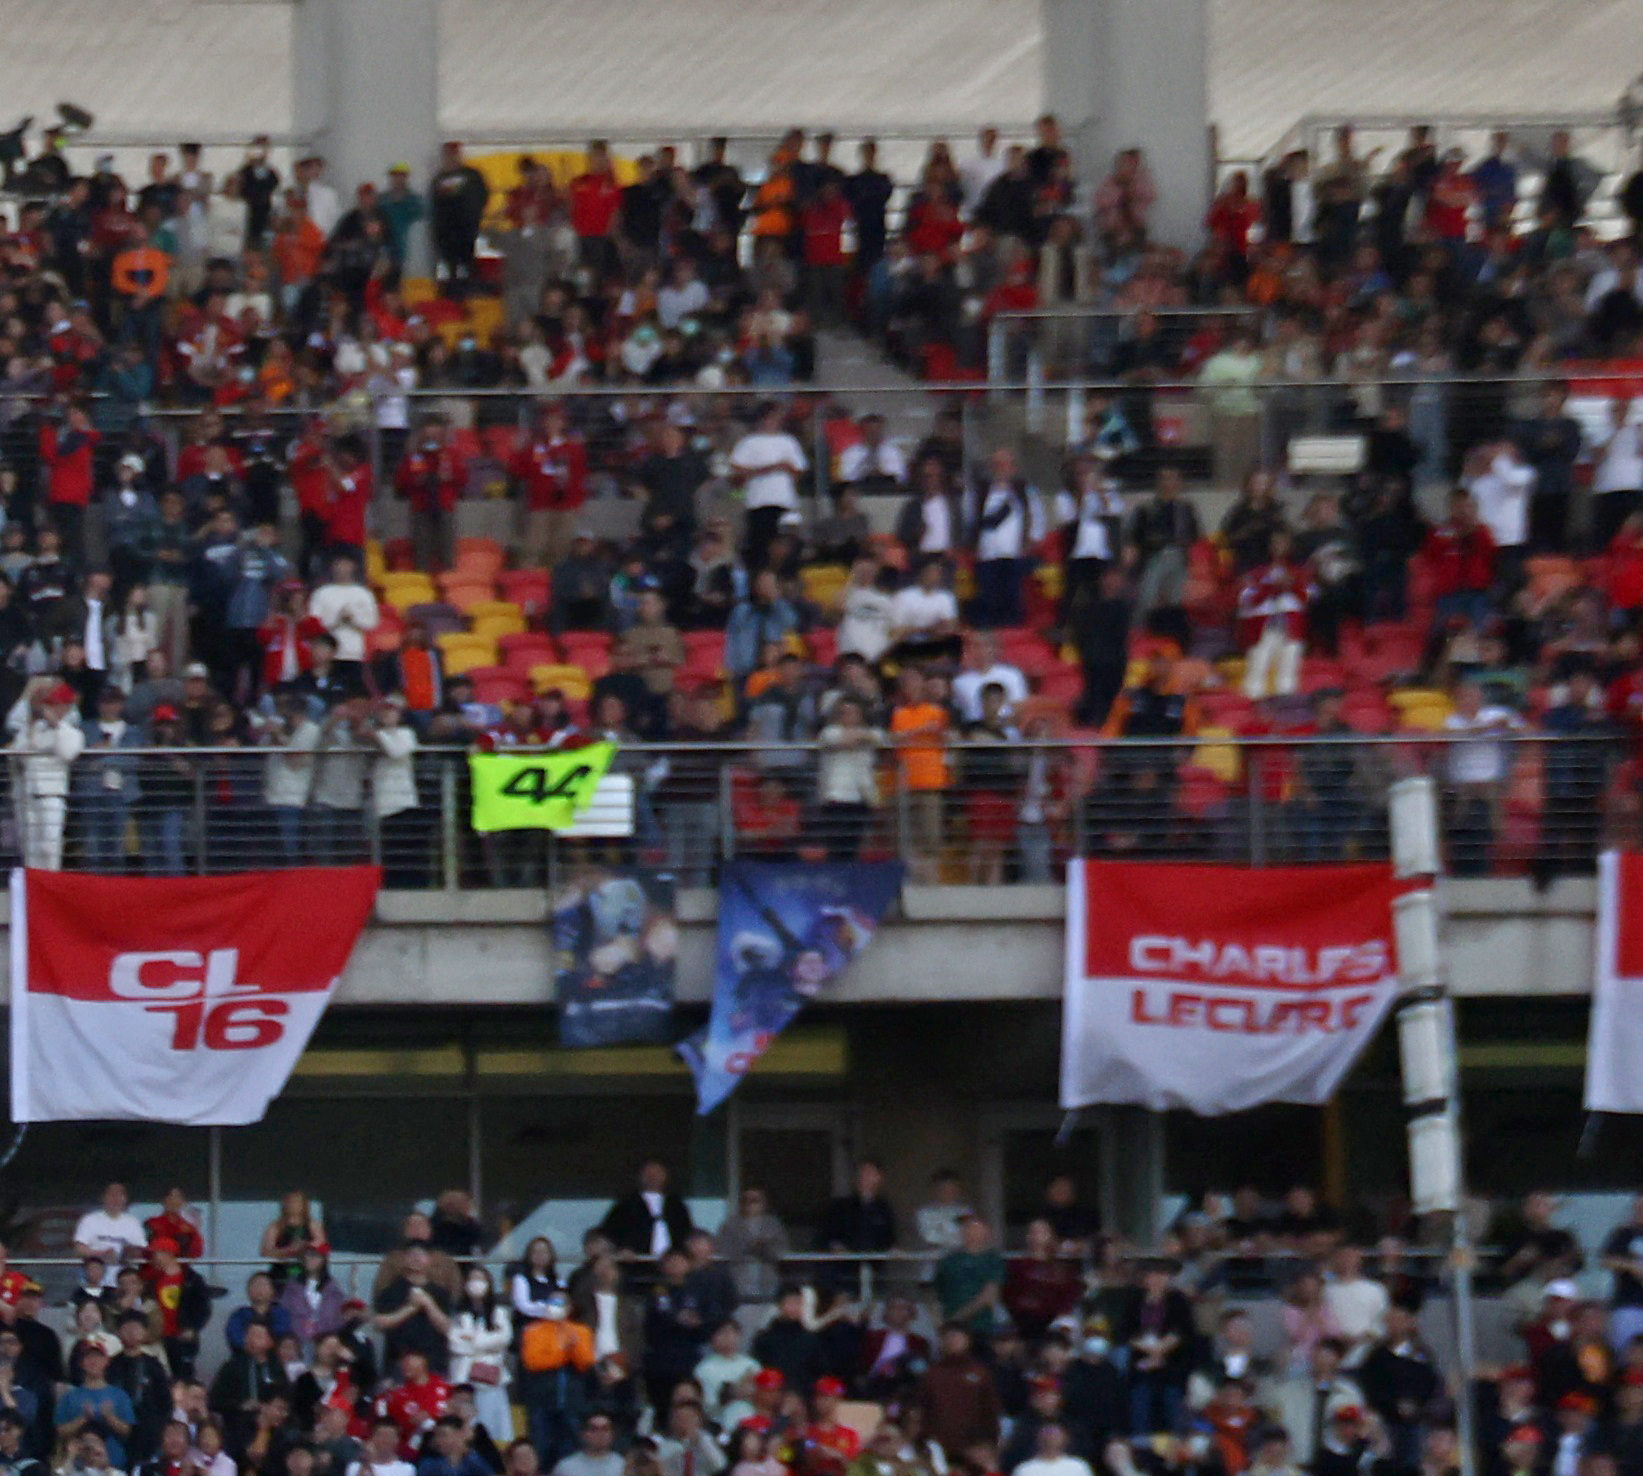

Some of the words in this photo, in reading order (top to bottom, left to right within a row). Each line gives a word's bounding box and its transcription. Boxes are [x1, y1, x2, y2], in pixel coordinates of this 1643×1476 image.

[107, 947, 262, 999] CL
[1128, 934, 1389, 984] CHARLES
[143, 999, 291, 1051] 16
